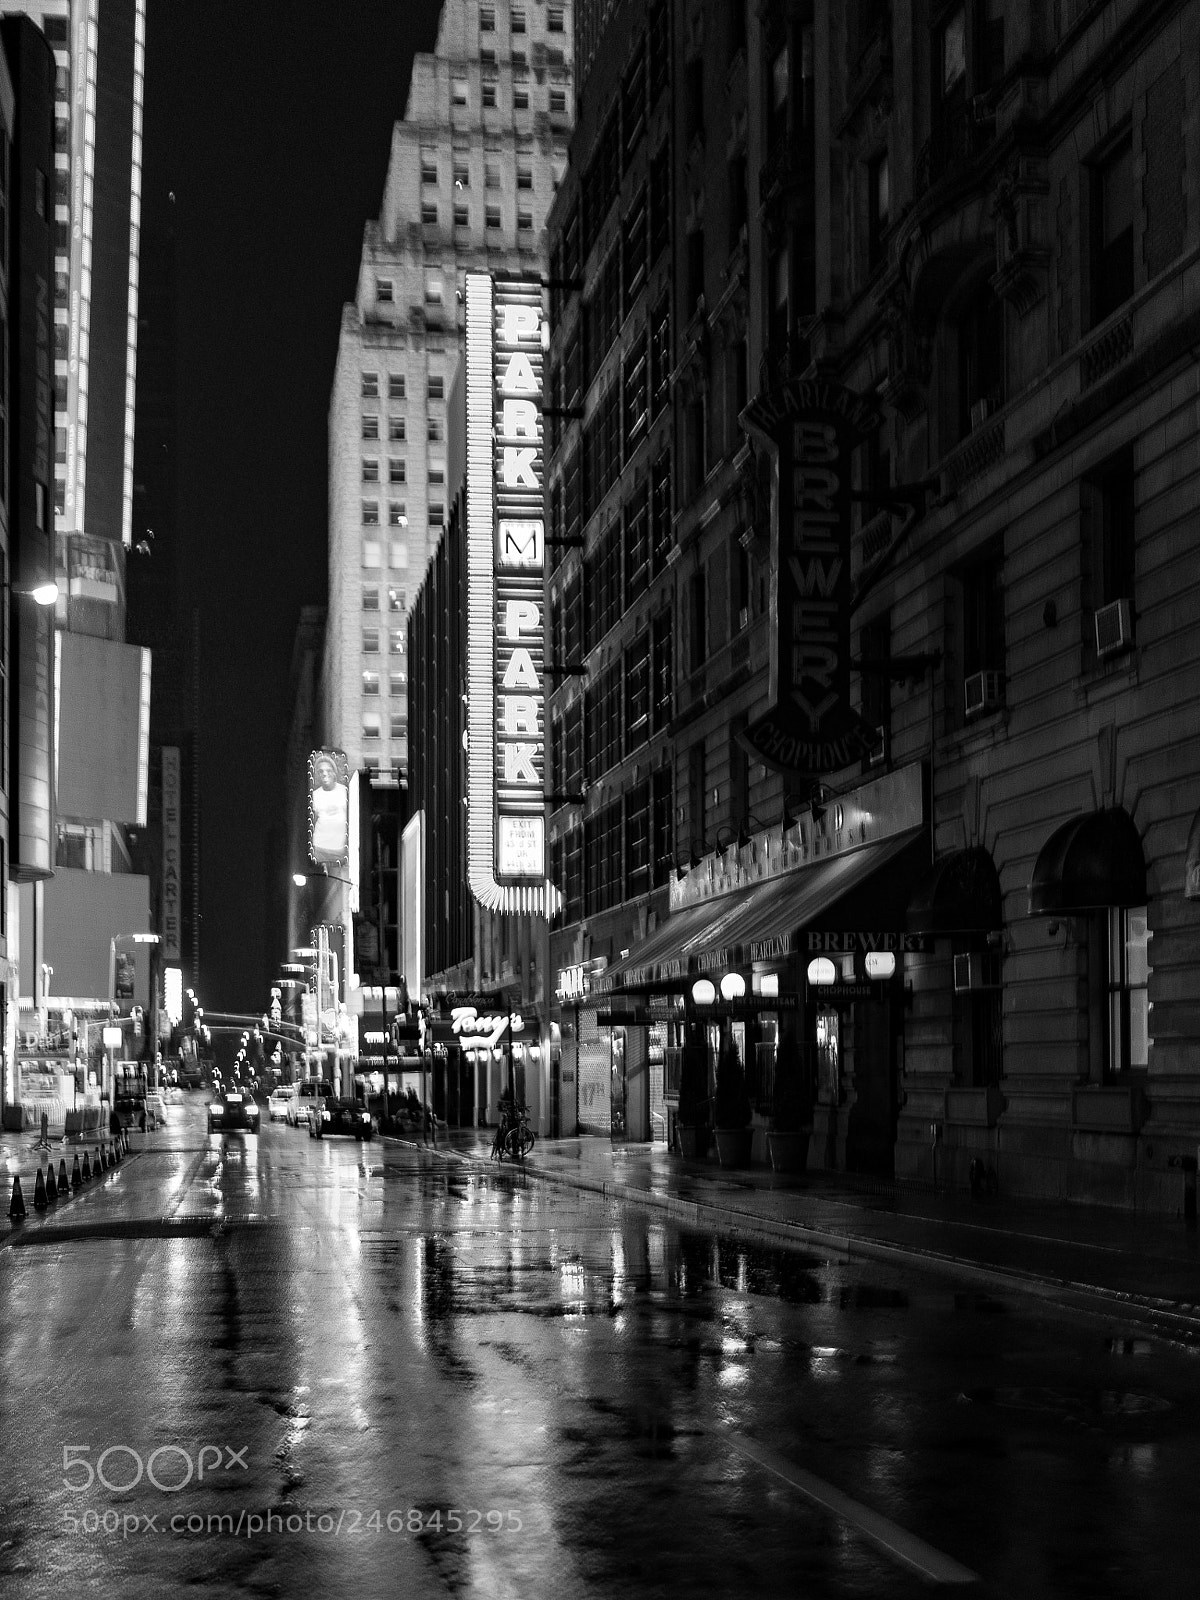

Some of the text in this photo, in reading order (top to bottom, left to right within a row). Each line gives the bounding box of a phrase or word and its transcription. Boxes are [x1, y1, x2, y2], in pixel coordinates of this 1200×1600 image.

[502, 304, 539, 488] PARK
[749, 383, 880, 432] HEARTLAND
[787, 421, 844, 734] BREWERY
[502, 600, 540, 784] PARK
[752, 722, 877, 769] CHOPHOUSE
[512, 820, 532, 829] EXIT
[165, 849, 177, 948] CARTER
[751, 933, 790, 961] HEARTLAND
[807, 931, 926, 951] BREWERY
[817, 985, 871, 996] CHOPHOUSE
[450, 1006, 525, 1050] Tony's
